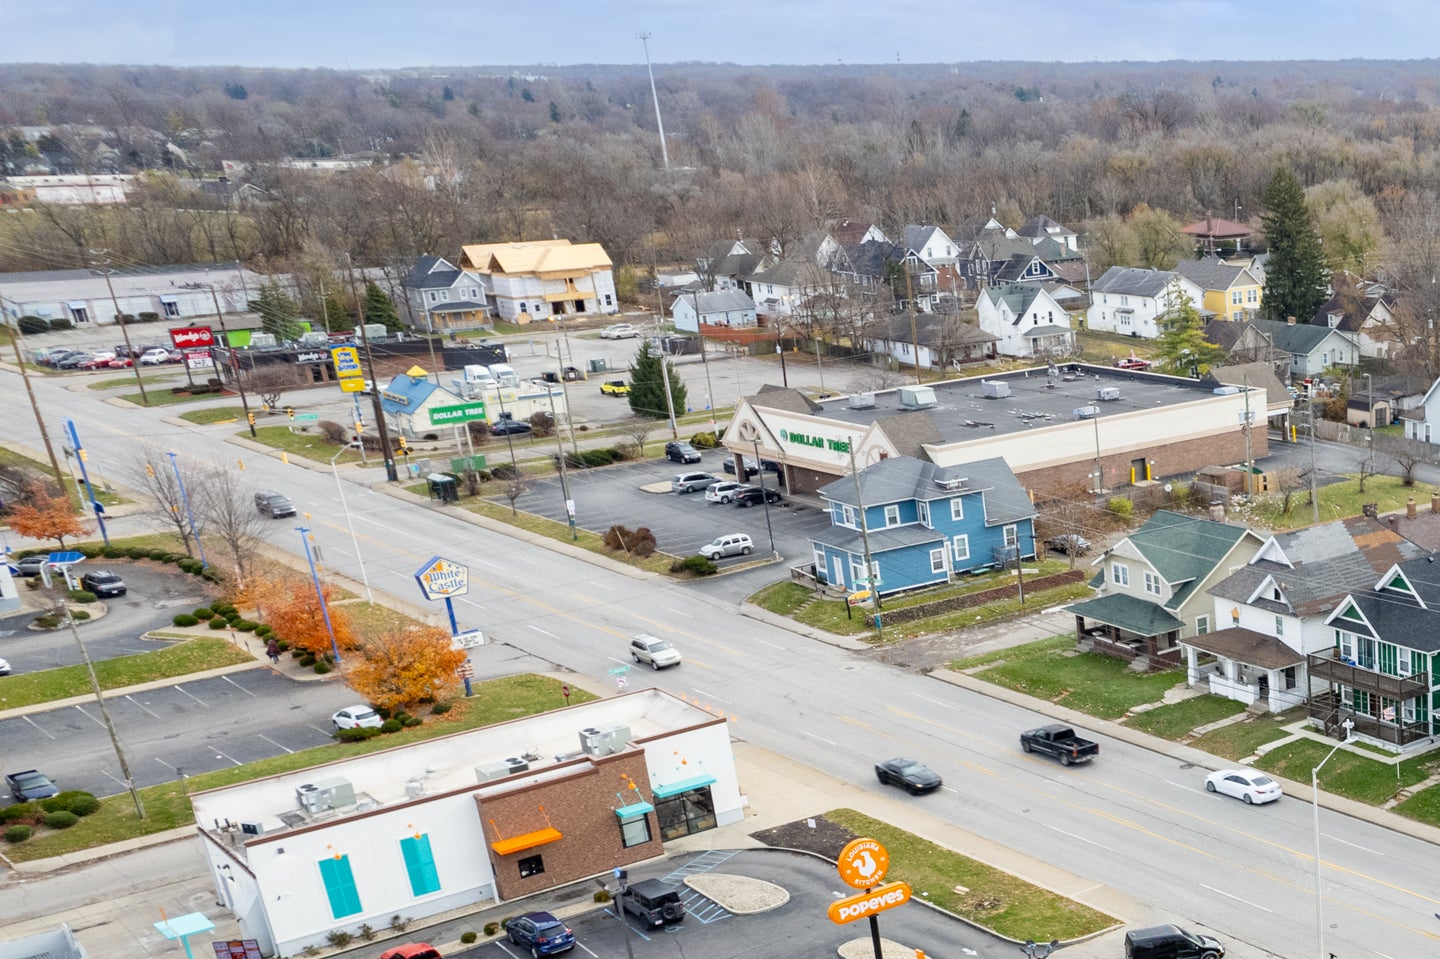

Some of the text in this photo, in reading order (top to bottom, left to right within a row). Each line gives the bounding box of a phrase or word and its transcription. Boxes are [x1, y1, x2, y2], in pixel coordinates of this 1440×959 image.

[433, 407, 483, 420] DOLLAR TREE
[789, 432, 850, 453] DOLLAR TREE
[428, 569, 461, 582] White
[429, 578, 464, 591] Castle
[846, 842, 880, 862] LOUISIANA
[854, 869, 884, 885] KITCHEN
